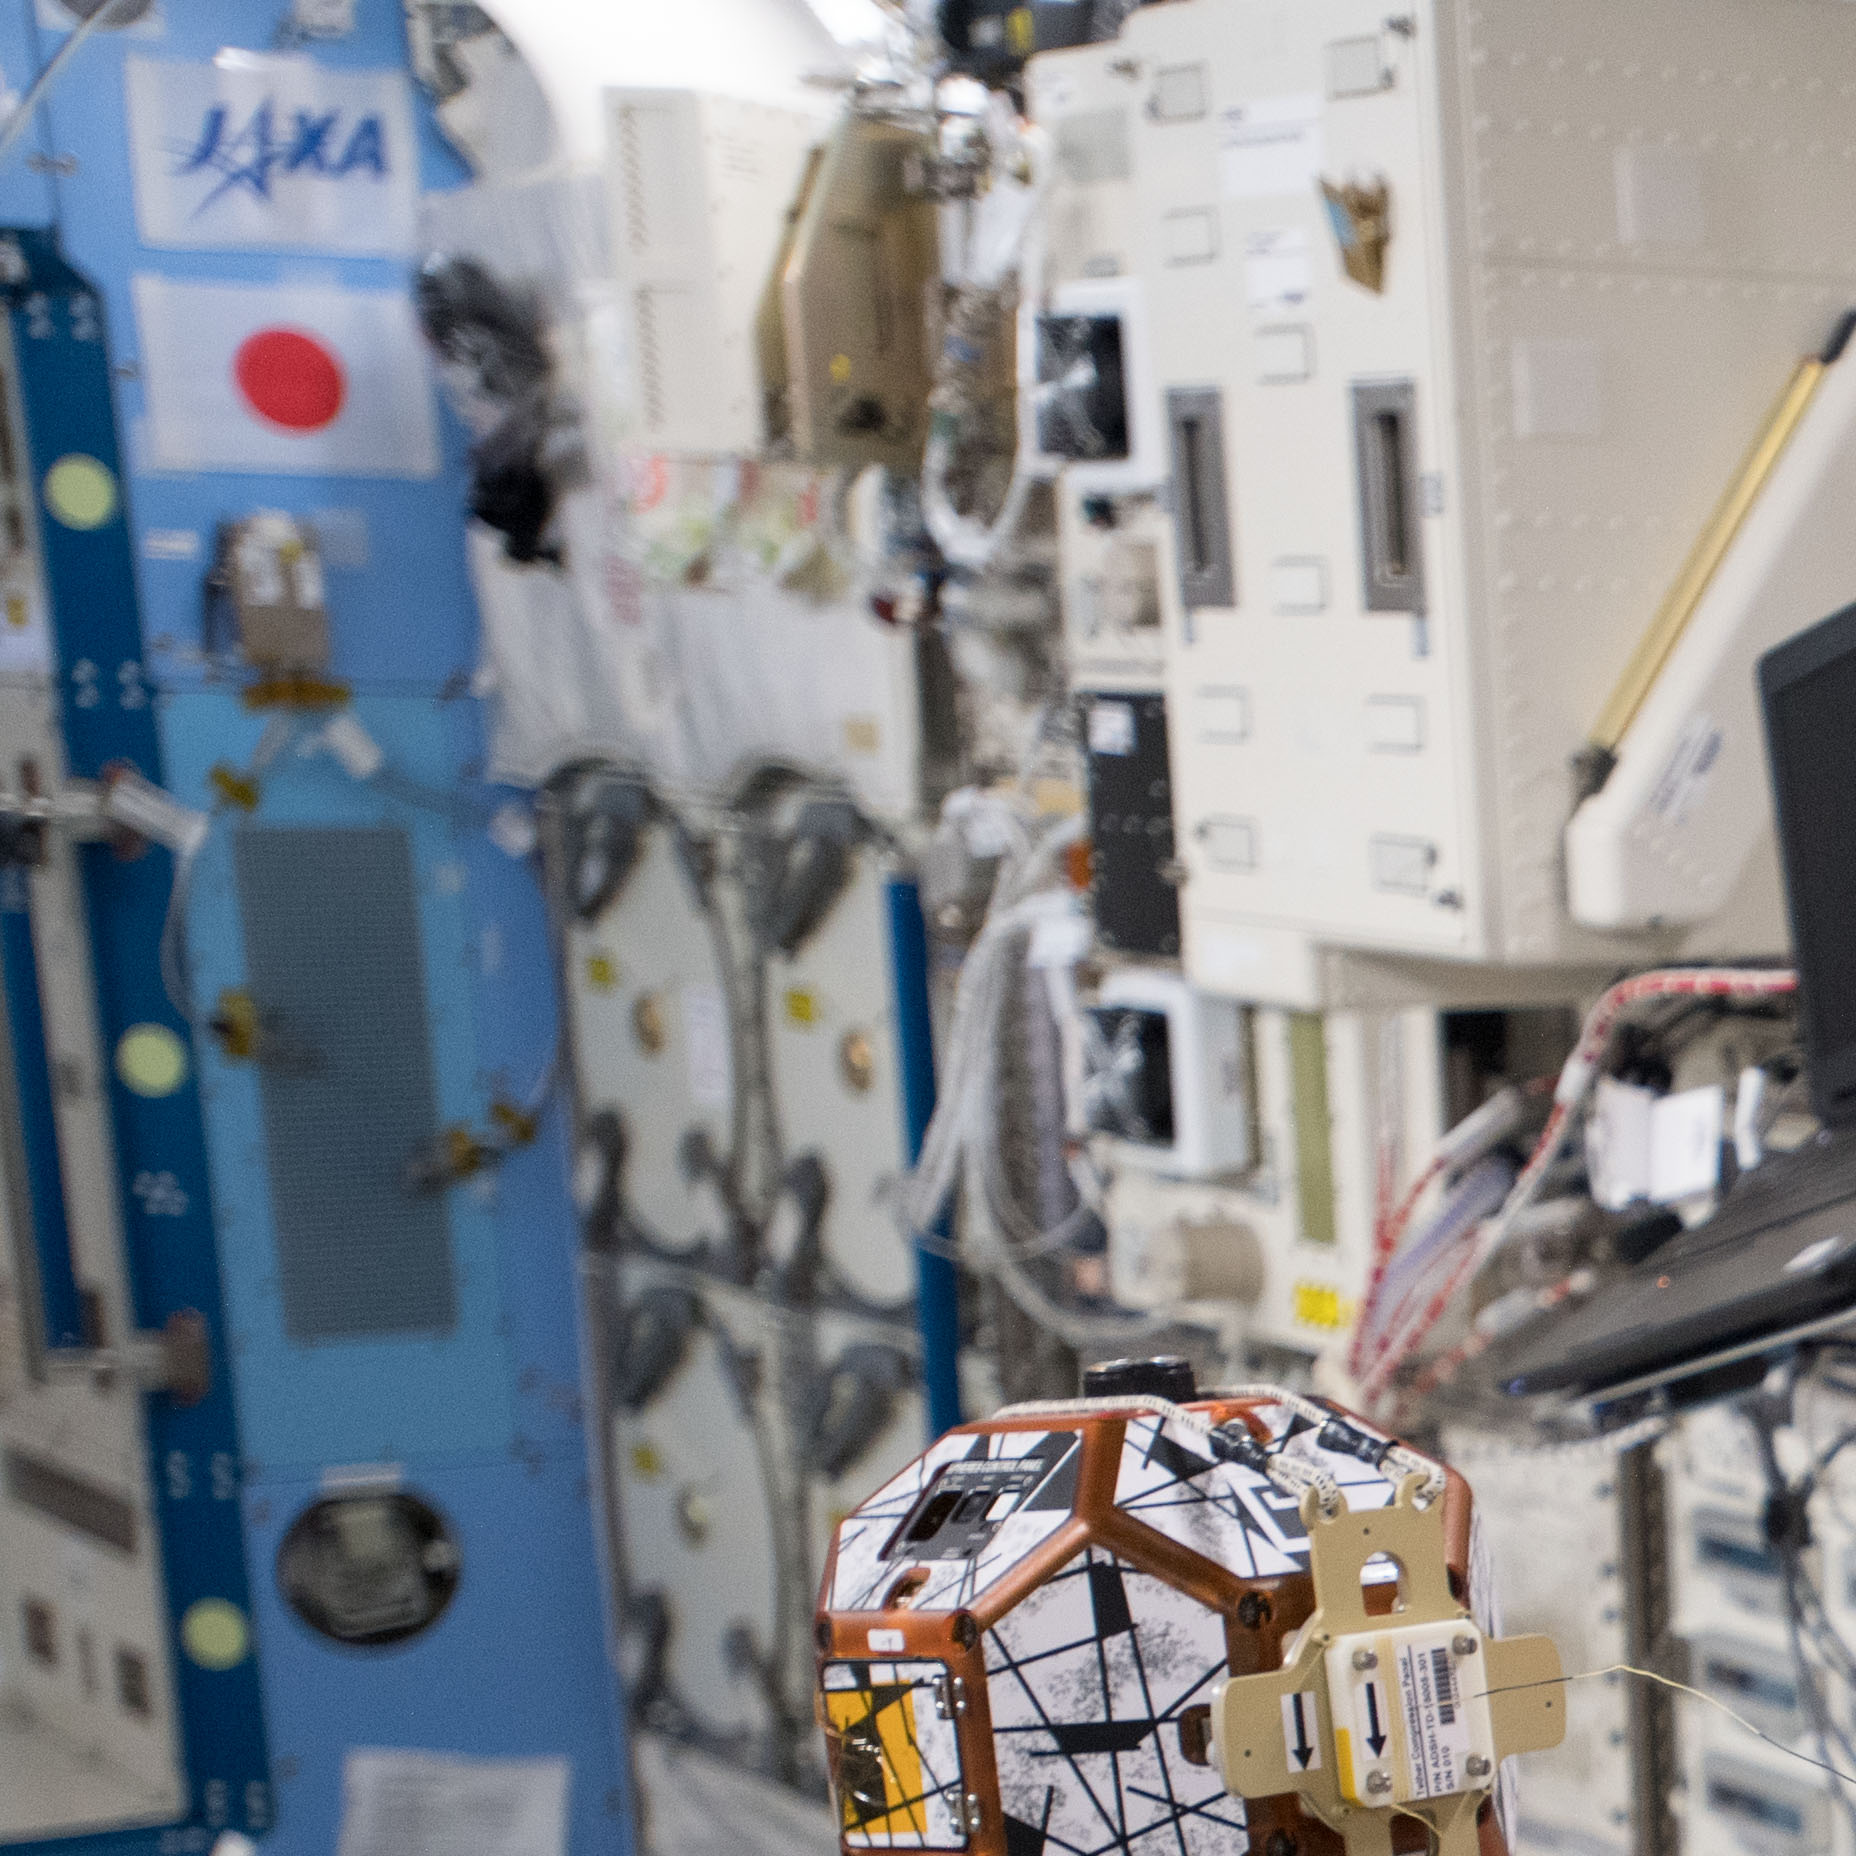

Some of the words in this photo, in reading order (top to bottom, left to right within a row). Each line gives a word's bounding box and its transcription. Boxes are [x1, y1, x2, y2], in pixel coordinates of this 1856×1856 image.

[173, 99, 388, 214] JAXA
[1400, 1657, 1411, 1688] Panel
[1406, 1690, 1421, 1760] Compression
[1415, 1762, 1425, 1796] Tether
[1433, 1772, 1443, 1793] P/N
[1444, 1769, 1455, 1791] S/N
